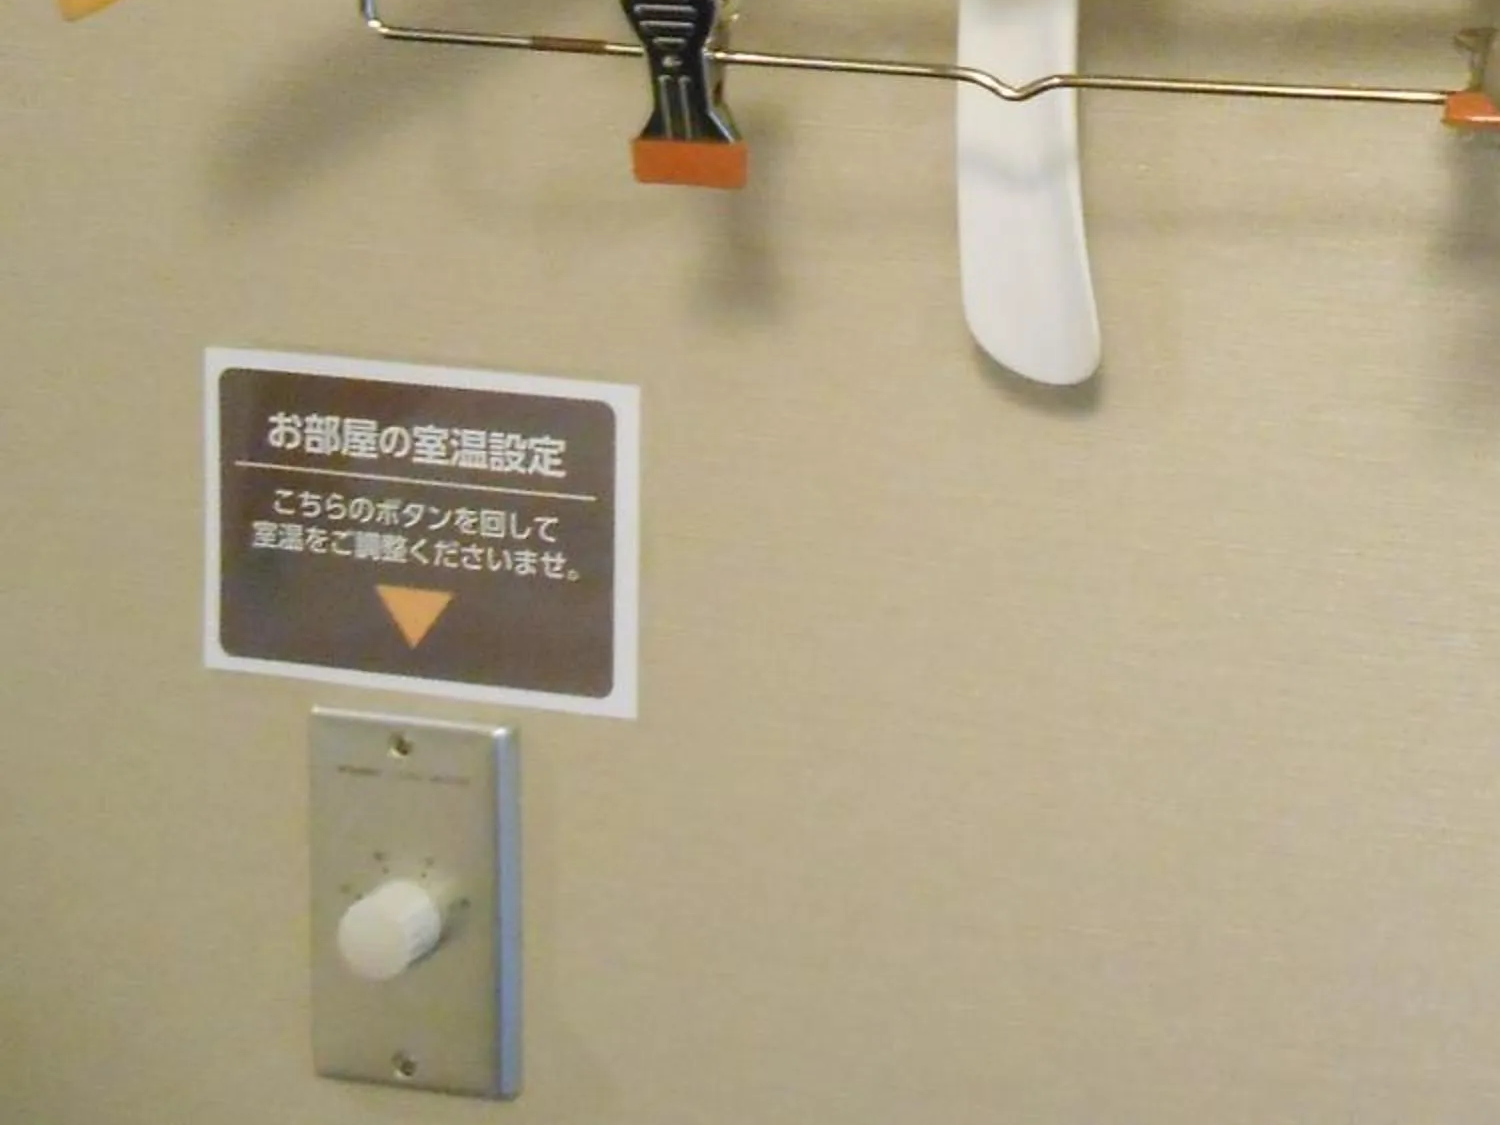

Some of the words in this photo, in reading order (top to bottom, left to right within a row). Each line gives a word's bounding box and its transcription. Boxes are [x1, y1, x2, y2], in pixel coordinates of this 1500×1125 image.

[267, 411, 568, 478] お部屋の室温設定
[273, 488, 559, 543] こちらのボタンを回して
[252, 520, 580, 582] 室温をご調整くださいませ。
